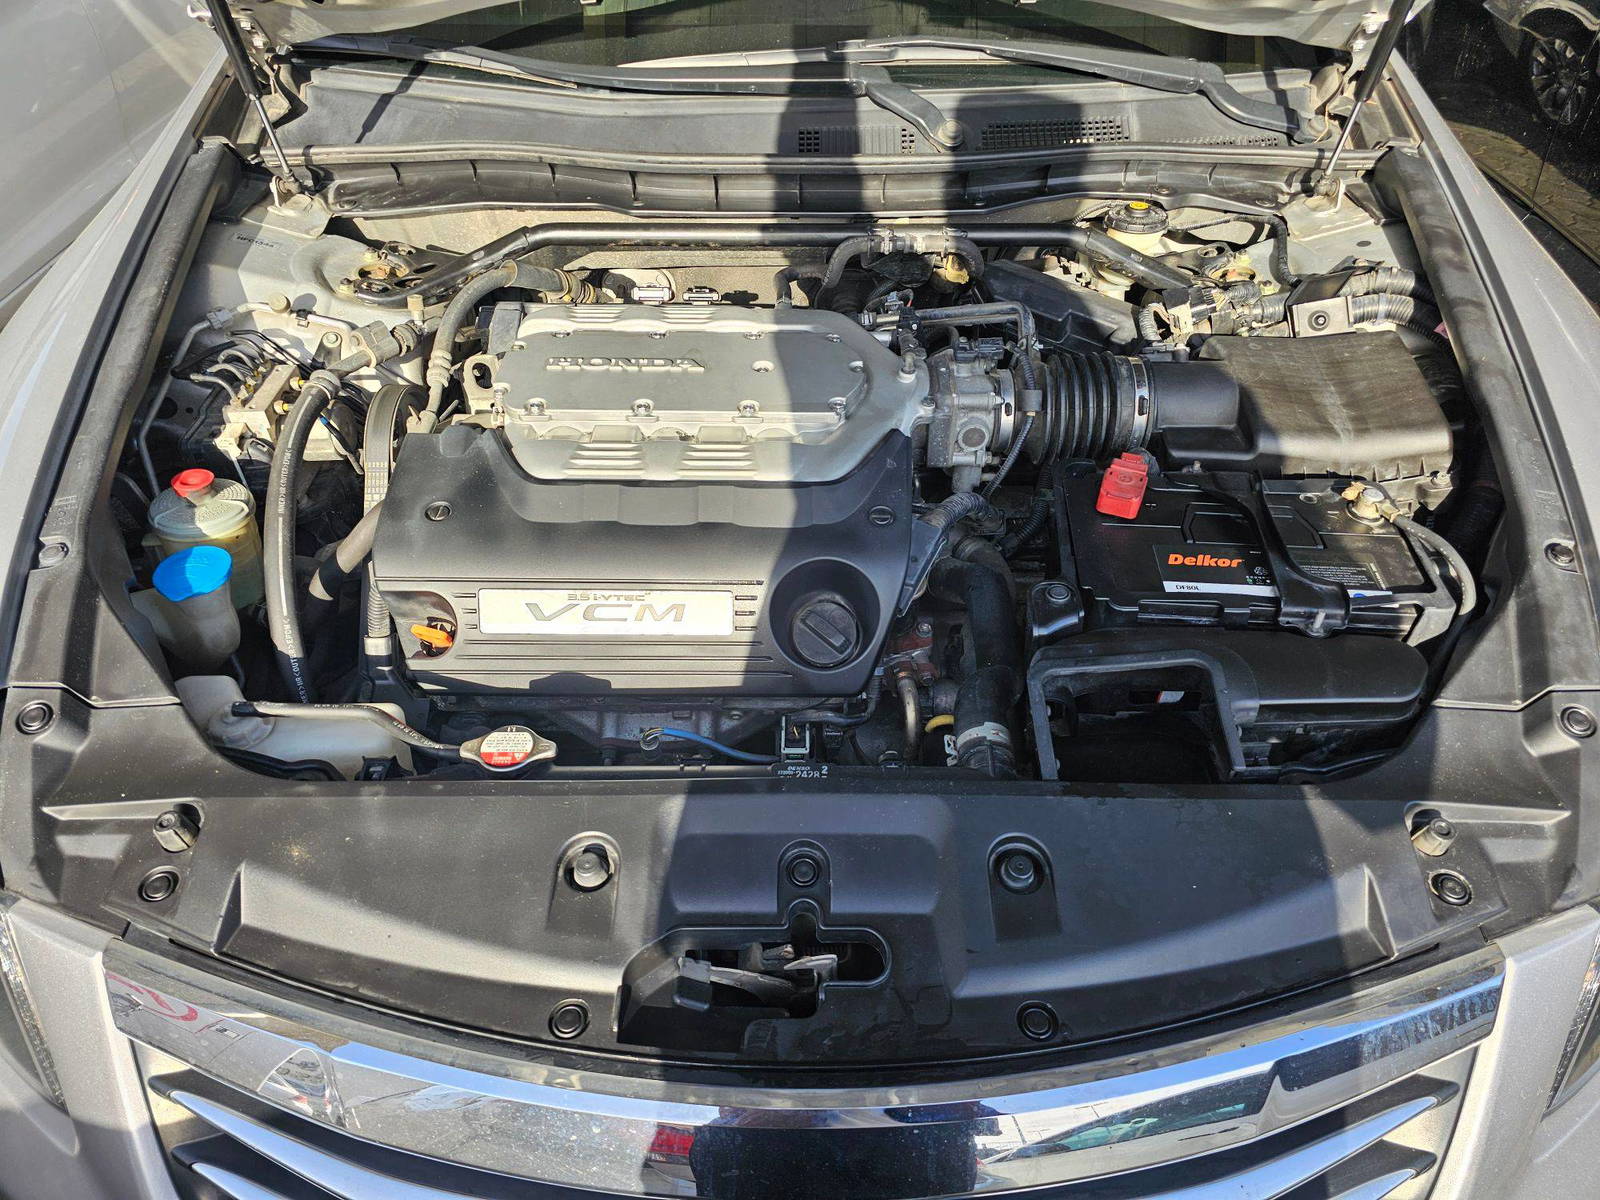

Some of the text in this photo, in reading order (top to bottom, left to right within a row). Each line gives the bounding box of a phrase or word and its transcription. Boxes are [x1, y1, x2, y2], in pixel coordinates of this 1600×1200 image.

[546, 357, 706, 372] HONDA
[1167, 553, 1243, 569] Delkor
[567, 593, 590, 601] 3.5
[525, 603, 687, 622] VCM
